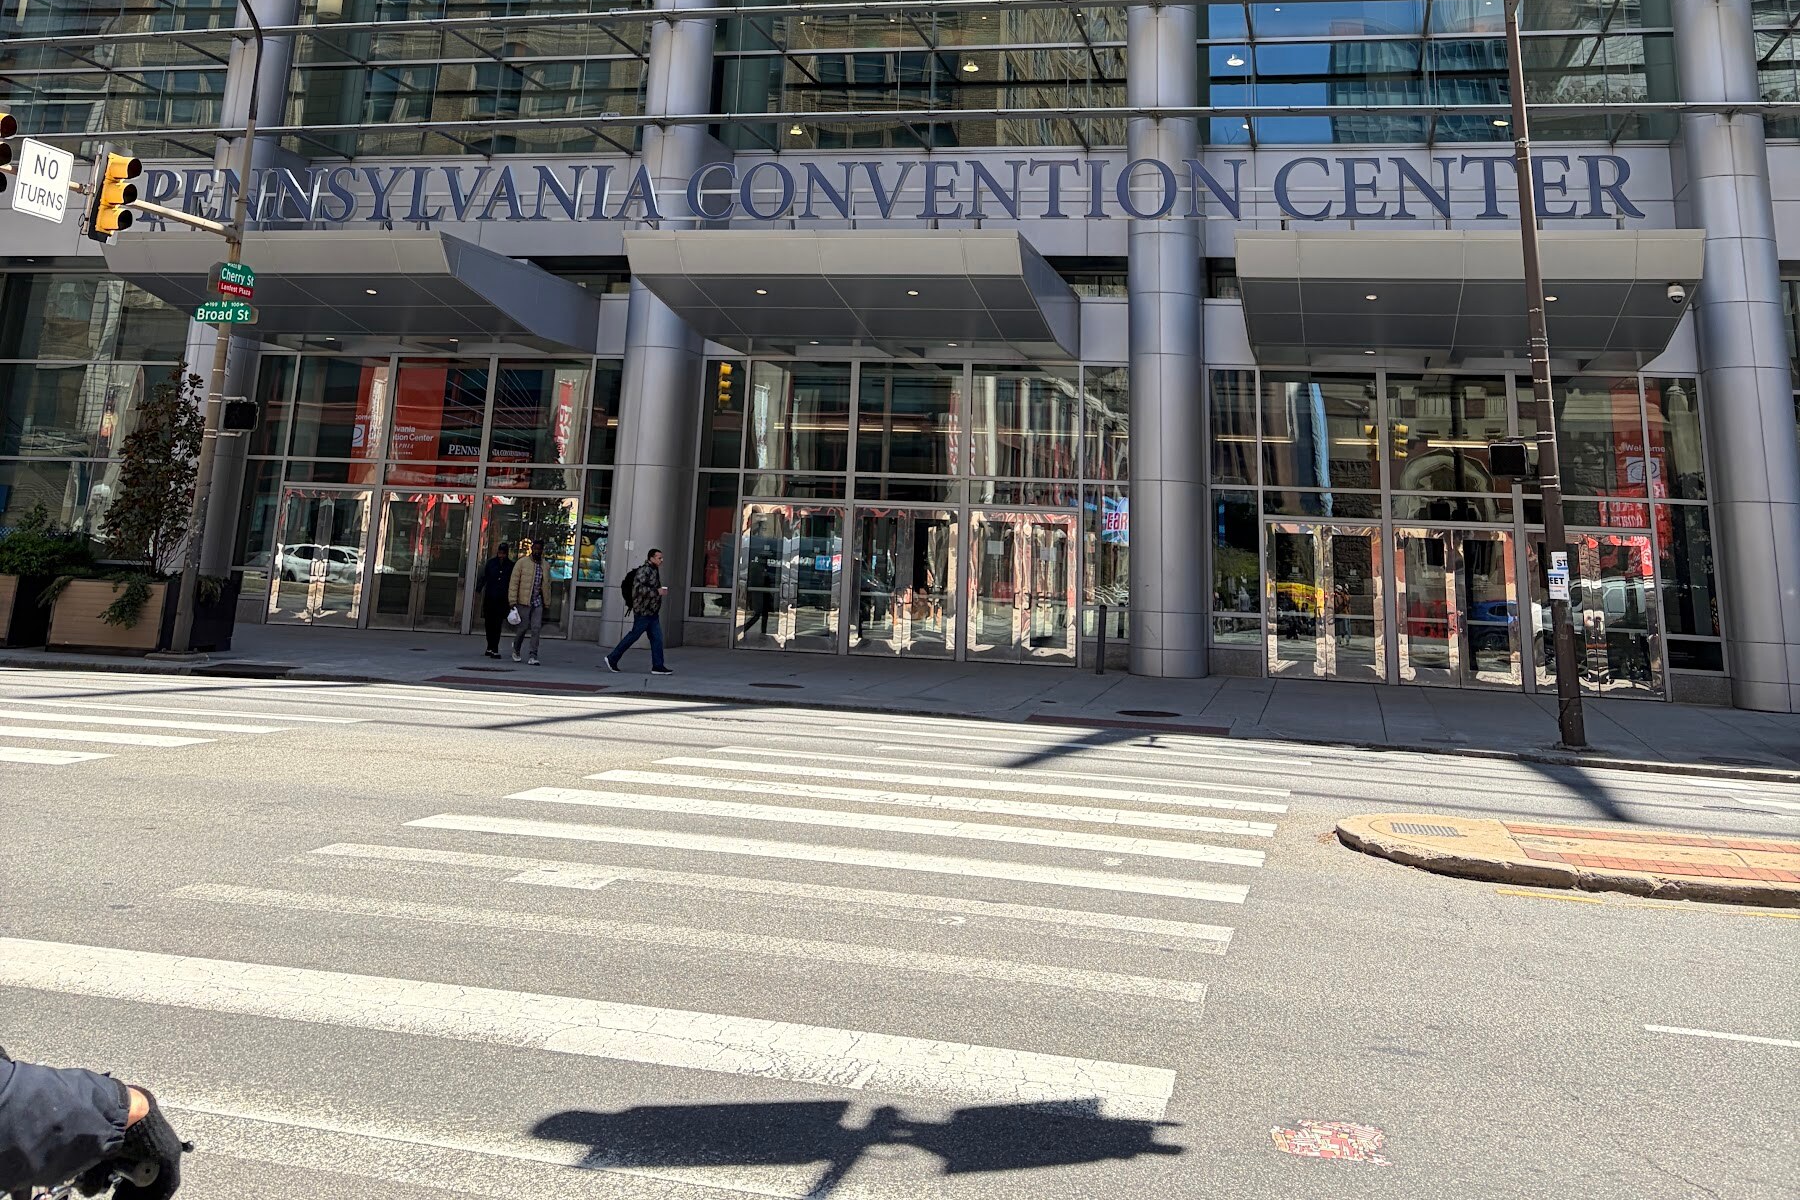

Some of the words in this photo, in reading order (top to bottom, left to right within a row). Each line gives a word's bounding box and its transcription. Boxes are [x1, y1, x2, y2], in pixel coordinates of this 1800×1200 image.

[34, 154, 59, 180] NO
[20, 182, 64, 211] TURNS
[137, 164, 664, 223] PENNSYLVANIA
[686, 157, 1248, 221] CONVENTION
[1273, 154, 1645, 222] CENTER
[221, 268, 245, 285] Cherry
[247, 275, 255, 287] St
[197, 308, 233, 321] Broad
[237, 309, 250, 321] St
[409, 433, 434, 442] Center
